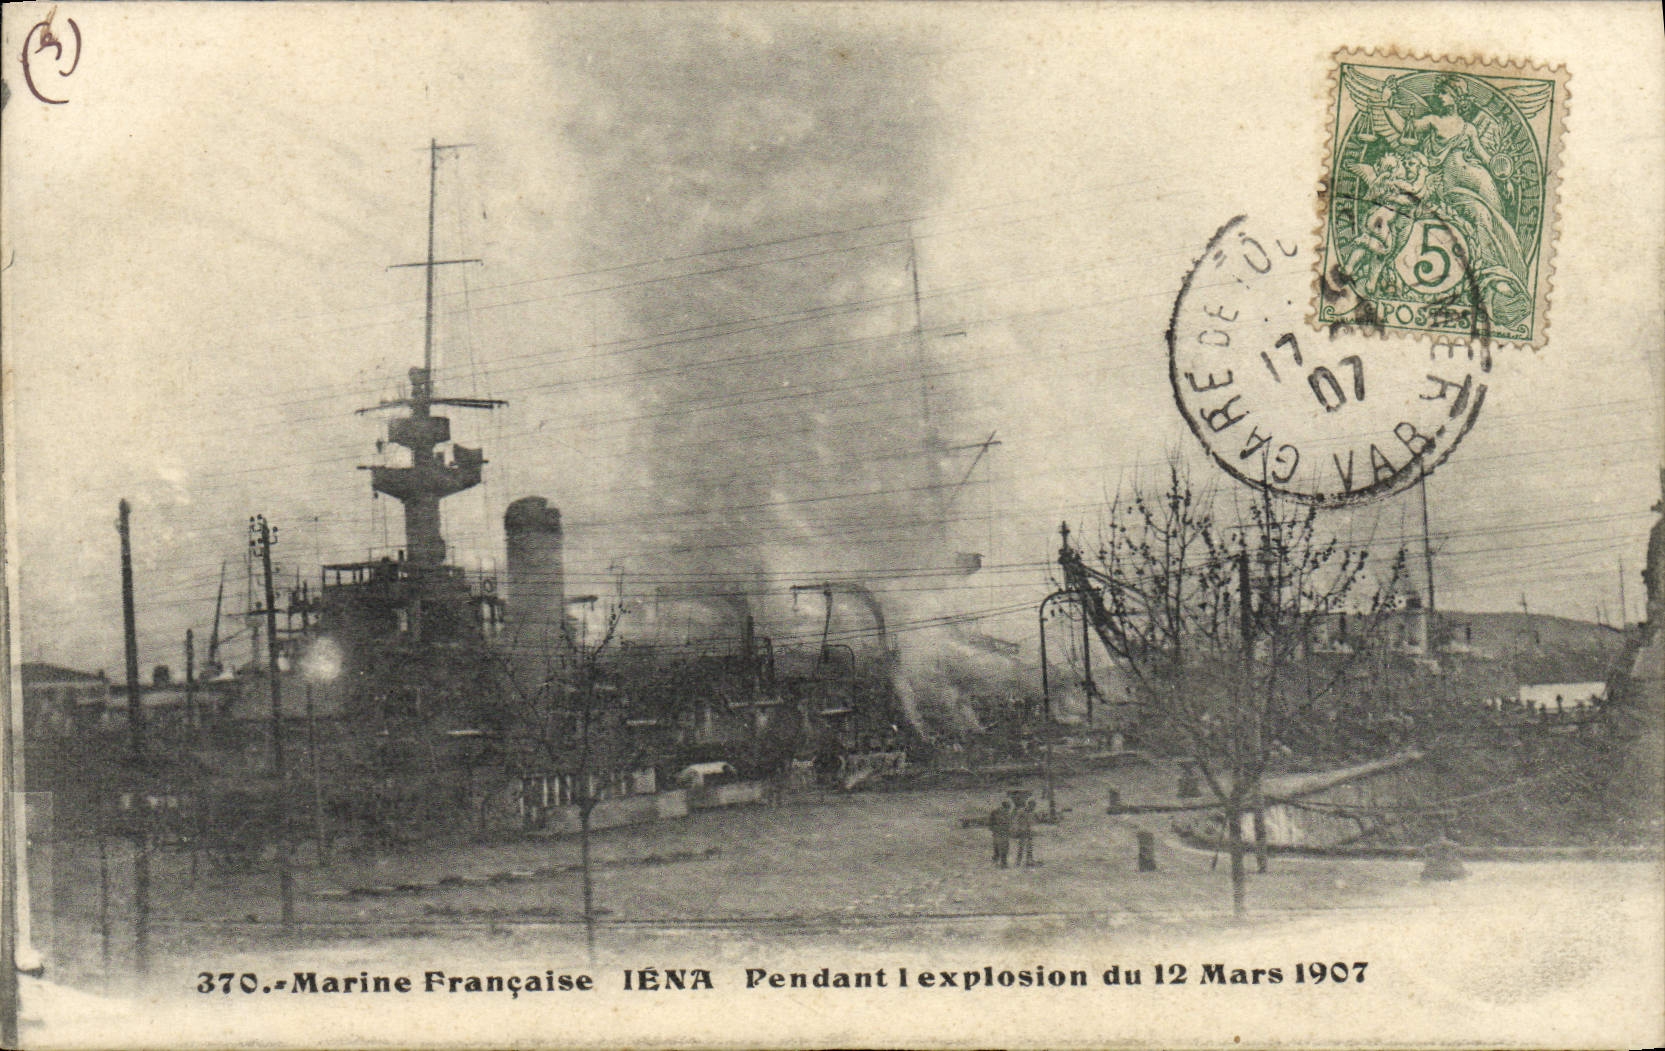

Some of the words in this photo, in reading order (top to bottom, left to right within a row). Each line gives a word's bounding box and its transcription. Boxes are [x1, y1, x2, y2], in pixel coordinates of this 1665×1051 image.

[1199, 304, 1239, 347] DE
[1380, 302, 1471, 329] POSTES
[1260, 332, 1303, 383] 17
[1307, 354, 1365, 413] 07
[1184, 369, 1302, 484] GARE
[1333, 421, 1436, 489] VAR
